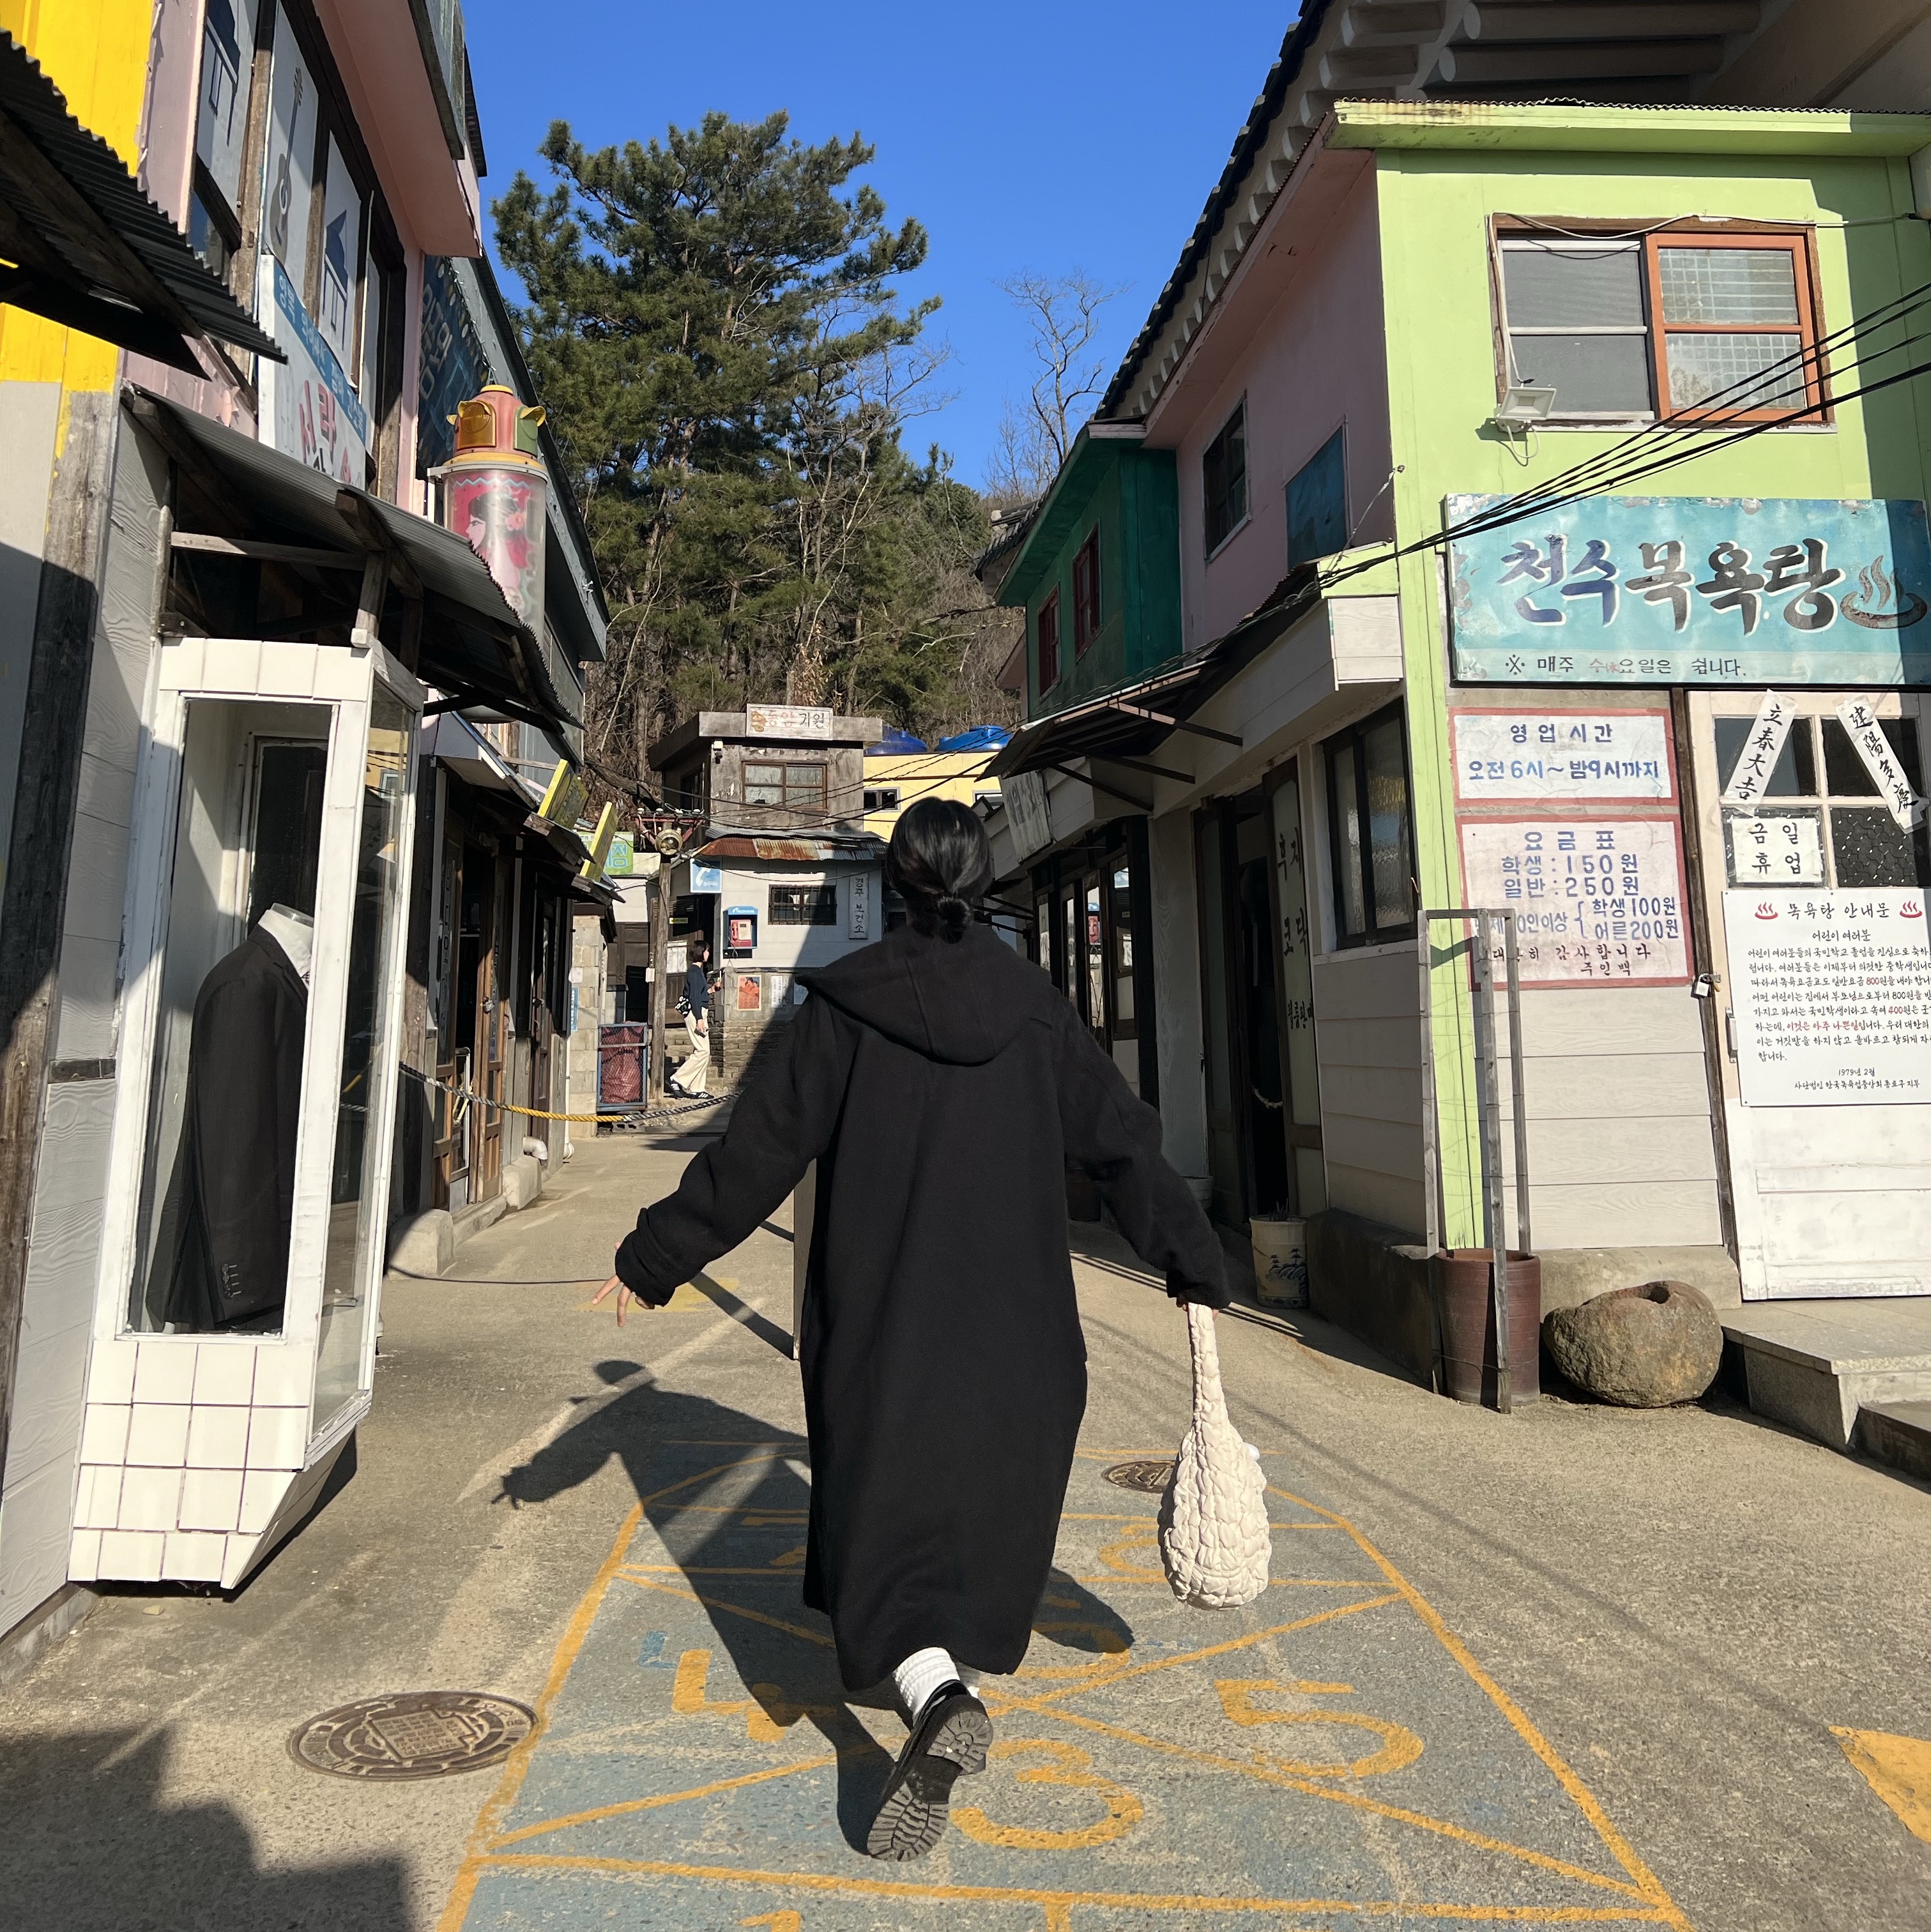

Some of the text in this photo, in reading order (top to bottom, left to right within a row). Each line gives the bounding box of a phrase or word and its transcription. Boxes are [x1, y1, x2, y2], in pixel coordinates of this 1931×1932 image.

[1497, 534, 1845, 636] 천수목욕탕
[1537, 655, 1574, 673] 매주
[1734, 703, 1783, 800] 立春大吉
[1749, 822, 1799, 844] 금일
[1752, 852, 1801, 874] 휴업
[1844, 902, 1890, 918] 안내문
[853, 903, 865, 934] 보건소
[1812, 929, 1872, 942] 어린이 여러분
[1748, 945, 1931, 958] 어린이 여러분들의 국민학교 졸업을 진심으로 축하
[1778, 961, 1821, 973] 여러분들은
[1824, 961, 1856, 973] 이제부터
[1858, 961, 1884, 972] 의젓한
[1750, 977, 1778, 987] 따라서
[1866, 975, 1895, 986] 800원을
[1914, 975, 1931, 987] 합니
[1771, 992, 1803, 1002] 어린이는
[1805, 991, 1829, 1002] 집에서
[1892, 989, 1923, 1001] 800원을
[1753, 1007, 1780, 1017] 가지고
[1781, 1006, 1806, 1017] 와서는
[1808, 1005, 1869, 1017] 국민학생이라고
[1888, 1004, 1920, 1015] 400원은
[1921, 1004, 1931, 1015] 군
[1787, 1020, 1810, 1032] 이것은
[1812, 1020, 1831, 1031] 아주
[1886, 1019, 1903, 1030] 우리
[1904, 1019, 1929, 1030] 대한의
[1757, 1036, 1773, 1047] 이는
[1775, 1035, 1811, 1047] 거짓말을
[1813, 1035, 1831, 1046] 하지
[1833, 1034, 1852, 1046] 않고
[1854, 1034, 1890, 1046] 올바르고
[1892, 1033, 1918, 1046] 참되게
[1838, 1067, 1861, 1076] 1979년
[1215, 1679, 1424, 1779] 5
[948, 1740, 1145, 1850] 3
